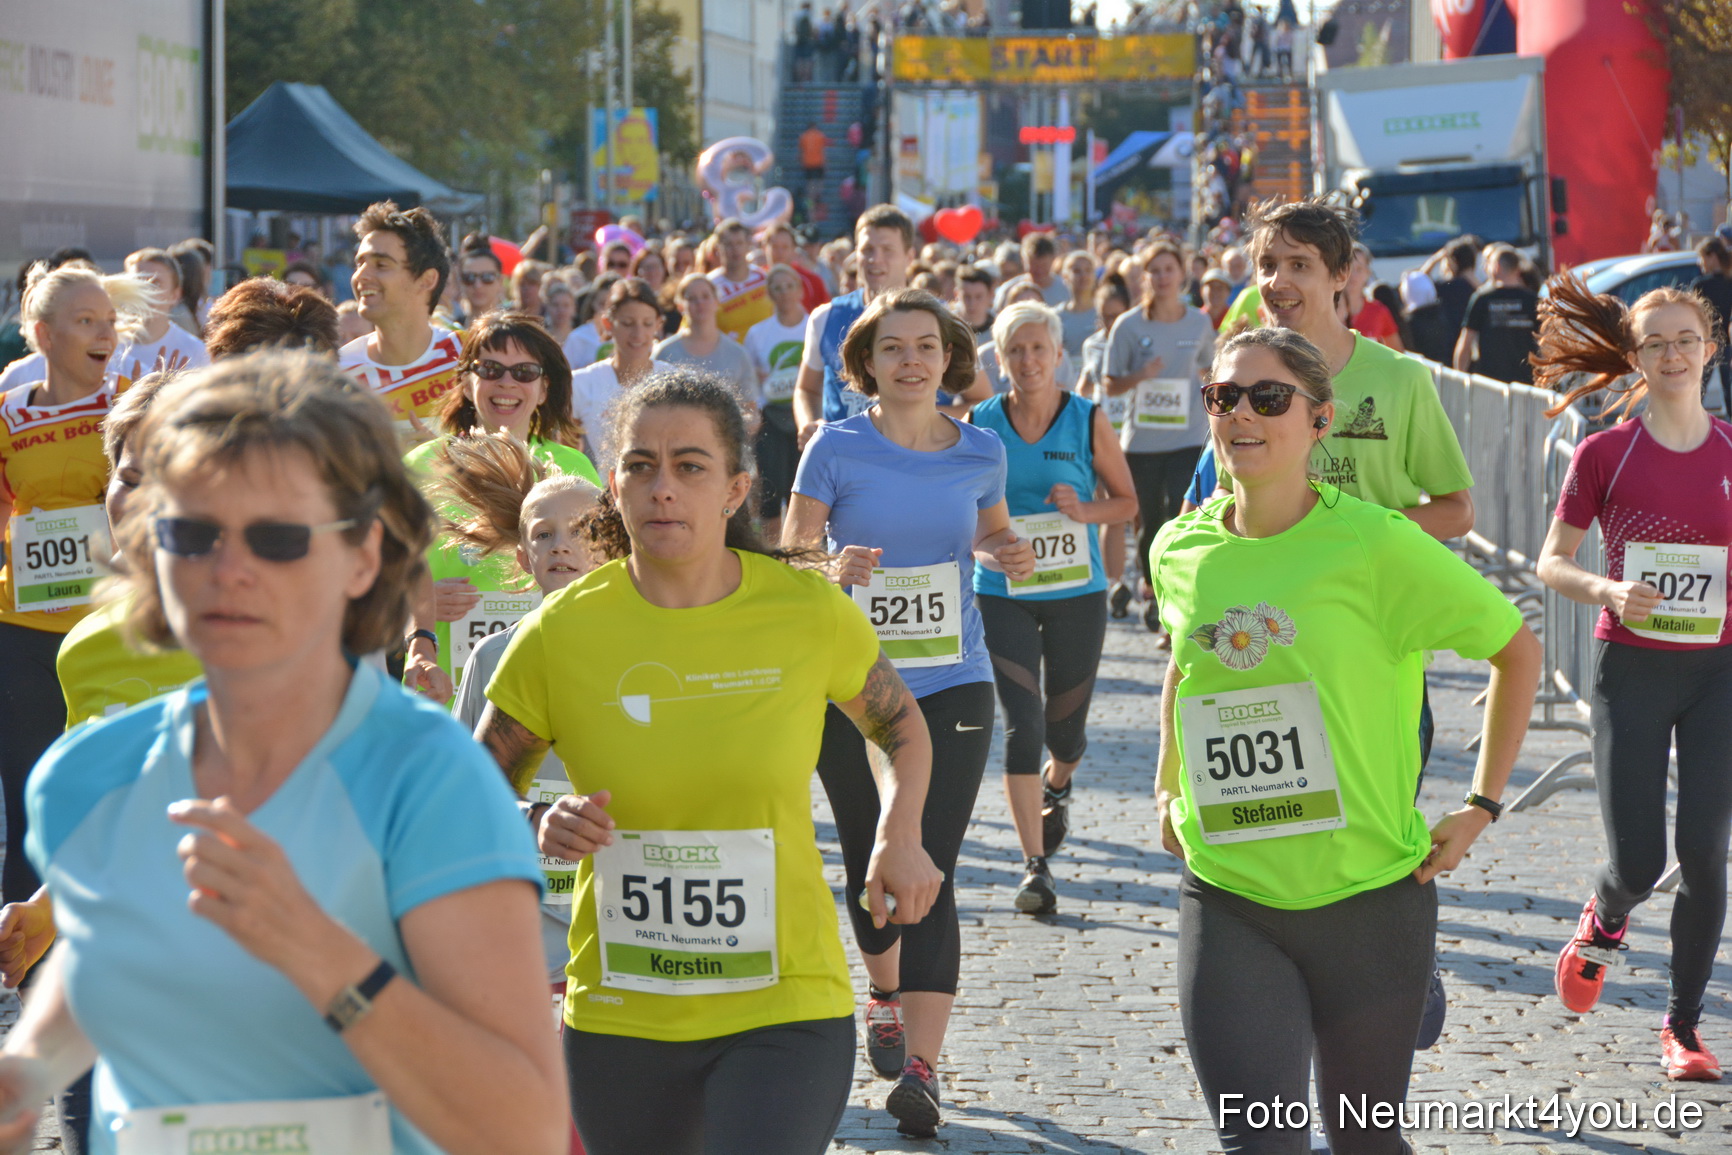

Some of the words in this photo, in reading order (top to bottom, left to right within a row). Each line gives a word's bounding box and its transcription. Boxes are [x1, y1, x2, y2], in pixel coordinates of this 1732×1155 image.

[11, 431, 57, 452] MAX
[1043, 451, 1076, 461] THULE
[36, 518, 79, 532] BOCK
[26, 535, 91, 570] 5091
[1032, 533, 1076, 559] 078
[1656, 553, 1700, 565] BOCK
[885, 574, 930, 587] BOCK
[1037, 573, 1063, 583] Anita
[48, 584, 81, 597] Laura
[1641, 571, 1712, 602] 5027
[484, 600, 532, 612] BOCK
[870, 592, 945, 626] 5215
[1653, 618, 1695, 632] Natalie
[685, 673, 720, 682] Kliniken
[712, 679, 753, 689] Neumarkt
[1218, 700, 1281, 722] BOCK
[1206, 727, 1304, 781] 5031
[1196, 774, 1203, 782] S
[1221, 786, 1250, 796] PARTL
[1251, 781, 1294, 793] Neumarkt
[1232, 800, 1303, 825] Stefanie
[643, 844, 720, 863] BOCK
[622, 874, 746, 928] 5155
[607, 909, 613, 918] S
[635, 929, 669, 942] PARTL
[671, 934, 721, 945] Neumarkt
[651, 953, 722, 976] Kerstin
[189, 1124, 308, 1155] BOCK
